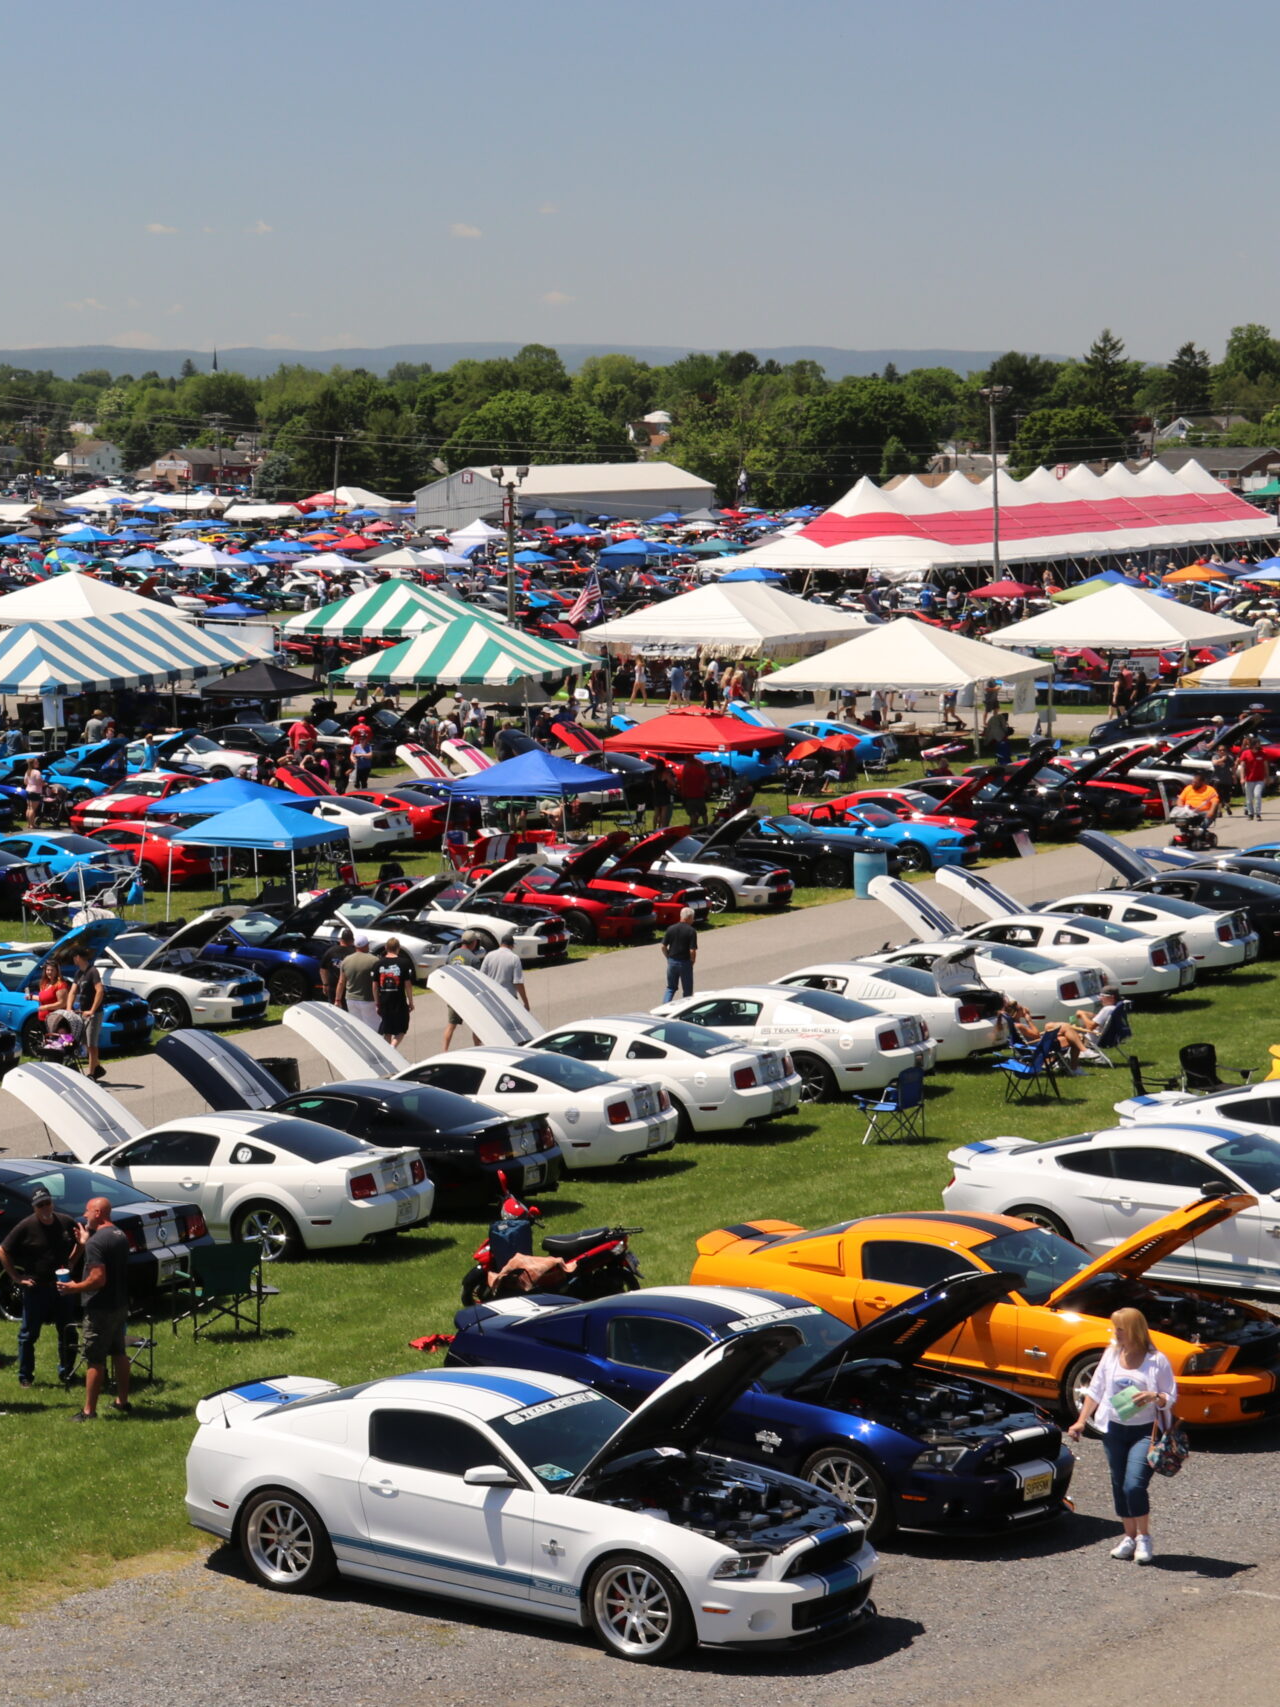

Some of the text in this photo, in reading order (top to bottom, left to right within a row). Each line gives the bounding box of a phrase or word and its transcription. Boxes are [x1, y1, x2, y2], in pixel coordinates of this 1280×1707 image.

[463, 473, 471, 483] R
[241, 1150, 250, 1160] 77
[523, 1391, 590, 1419] TEAM SHELBY
